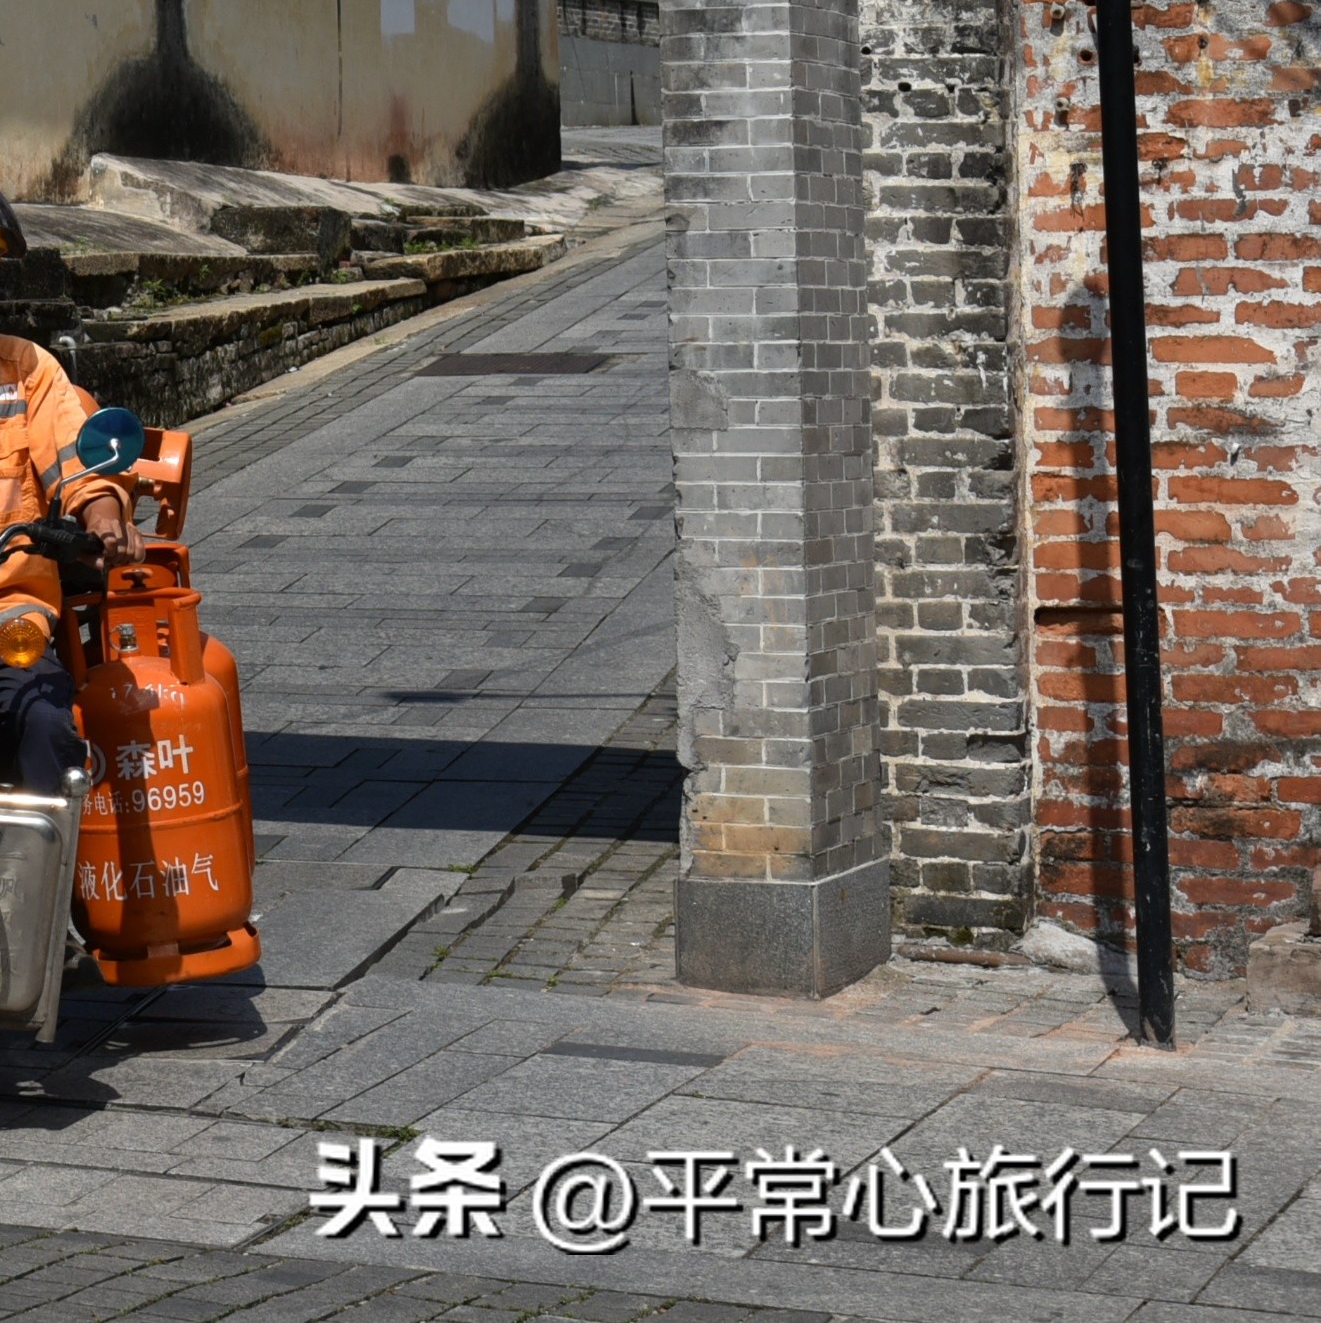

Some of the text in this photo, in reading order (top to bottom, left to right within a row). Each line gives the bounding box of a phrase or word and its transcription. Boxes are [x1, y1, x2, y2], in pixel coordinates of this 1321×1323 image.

[116, 734, 194, 780] 森叶
[77, 852, 220, 902] 液化石油气
